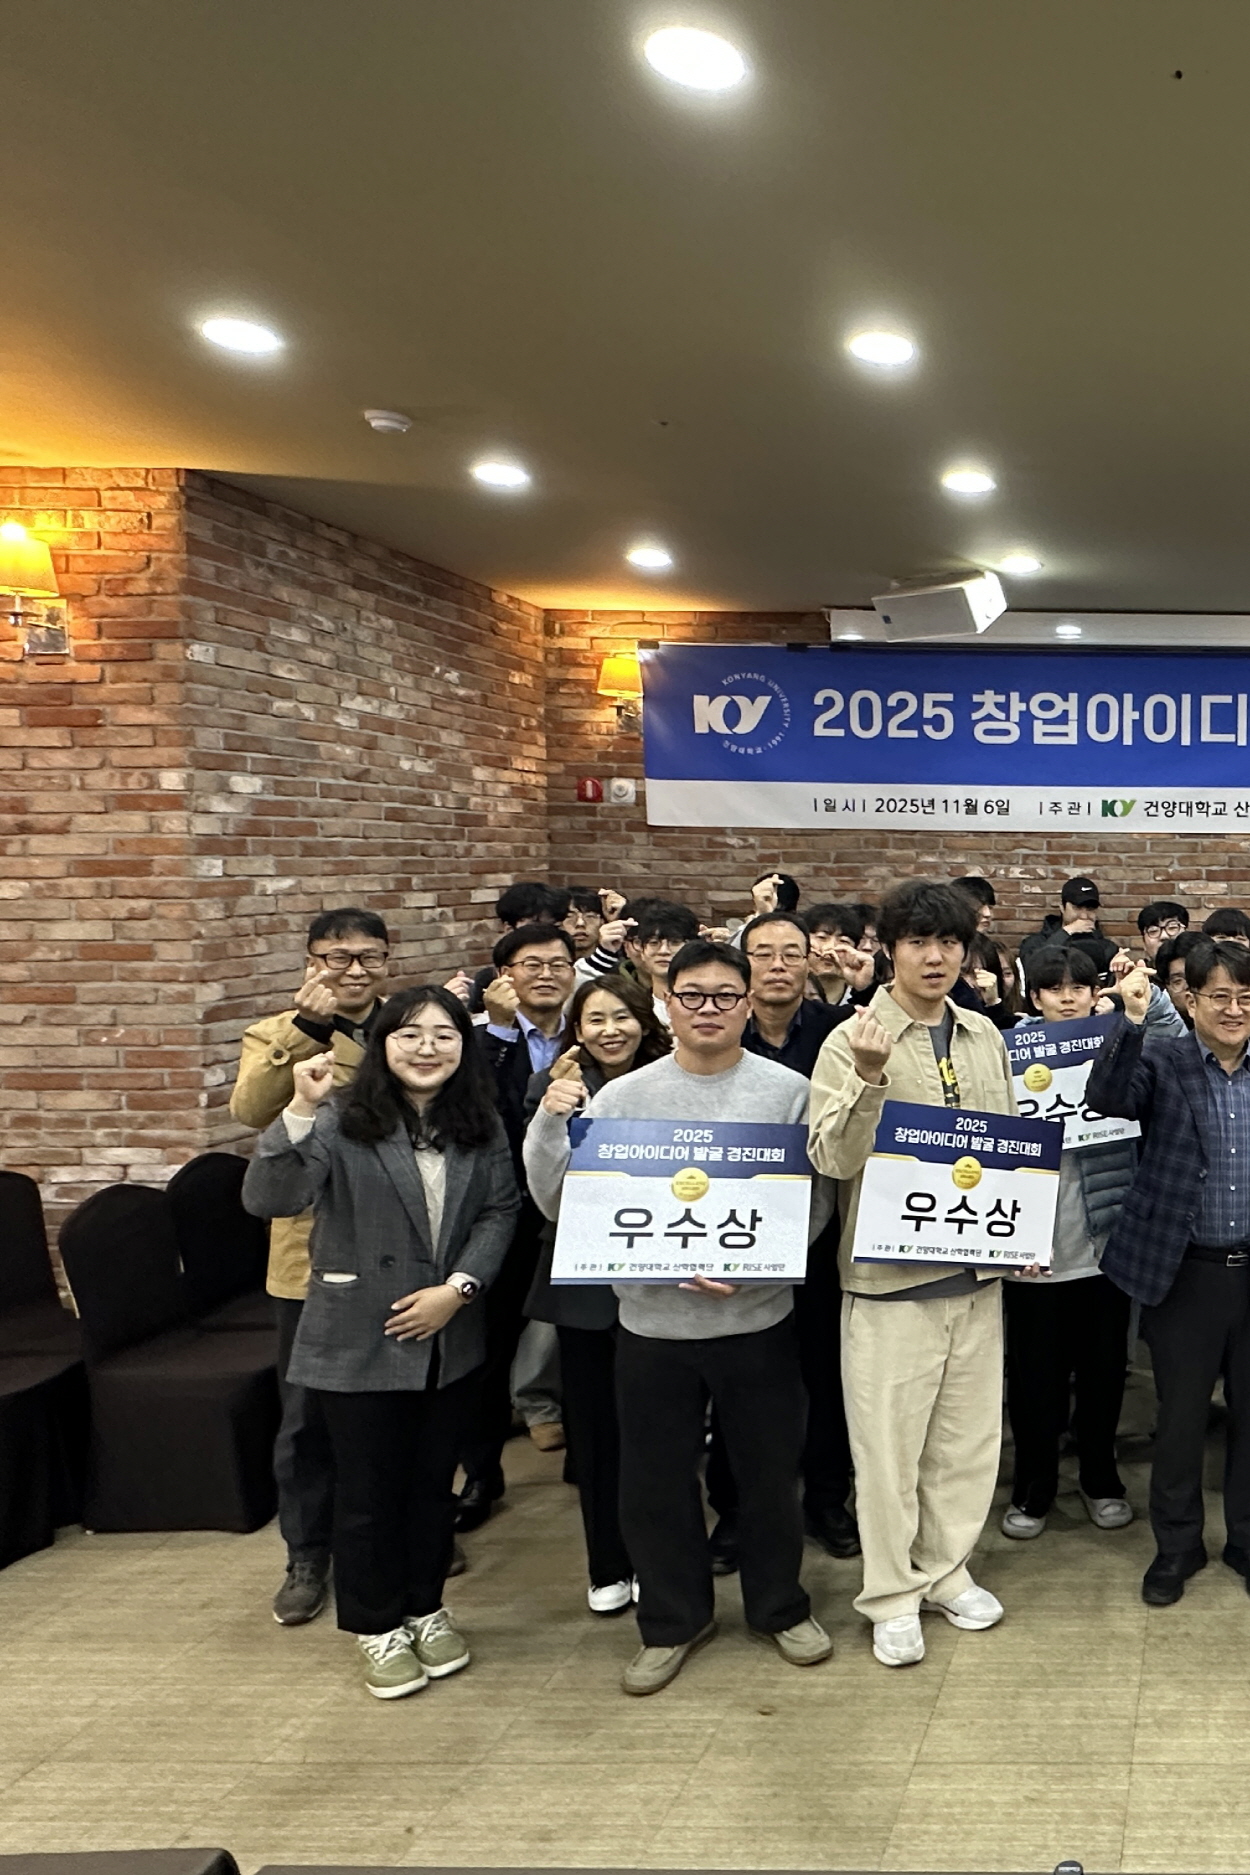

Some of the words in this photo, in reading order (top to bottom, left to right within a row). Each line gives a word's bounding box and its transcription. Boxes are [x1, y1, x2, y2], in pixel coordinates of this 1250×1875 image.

[721, 672, 766, 686] KONYANG
[767, 679, 791, 728] UNIVERSITY
[813, 688, 954, 741] 2025
[874, 797, 936, 815] 2025년
[941, 798, 979, 816] 11월
[983, 798, 1011, 816] 6일
[1143, 800, 1228, 819] 건양대학교
[1014, 1030, 1046, 1046] 2025
[955, 1117, 989, 1133] 2025
[673, 1128, 714, 1143] 2025
[894, 1126, 969, 1149] 창업아이디어
[970, 1135, 995, 1153] 발굴
[997, 1138, 1042, 1157] 경진대회
[597, 1143, 690, 1161] 창업아이디어
[693, 1146, 723, 1162] 발굴
[727, 1146, 785, 1163] 경진대회
[900, 1191, 1021, 1238] 우수상
[608, 1207, 763, 1250] 우수상
